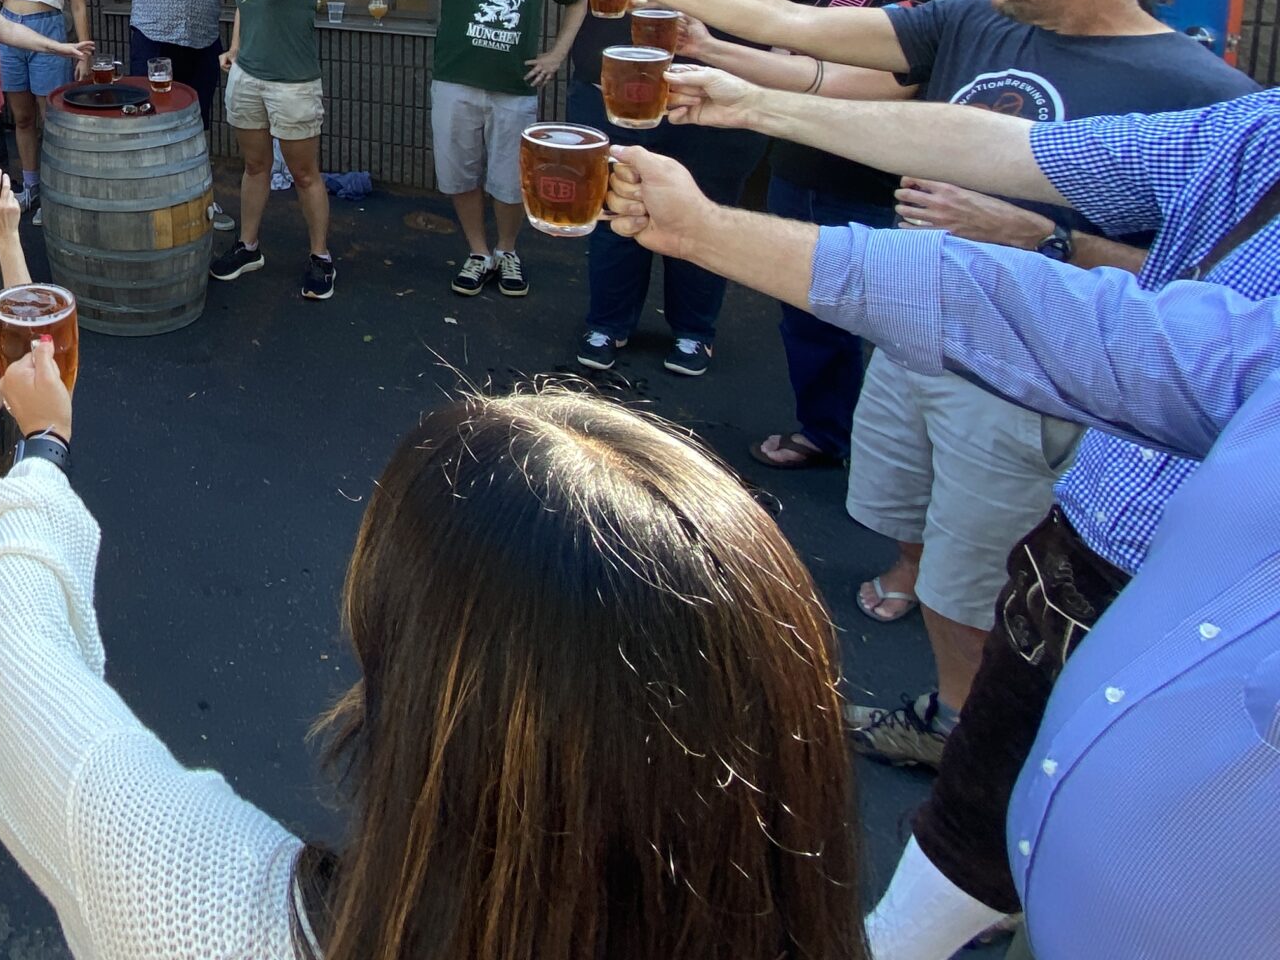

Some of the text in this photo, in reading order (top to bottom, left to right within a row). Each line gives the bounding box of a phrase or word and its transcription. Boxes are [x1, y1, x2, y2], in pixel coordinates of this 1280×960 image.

[466, 21, 522, 46] MÜNCHEN
[471, 37, 513, 53] GERMANY
[958, 80, 1005, 106] NDATION
[1004, 78, 1046, 106] BREWING
